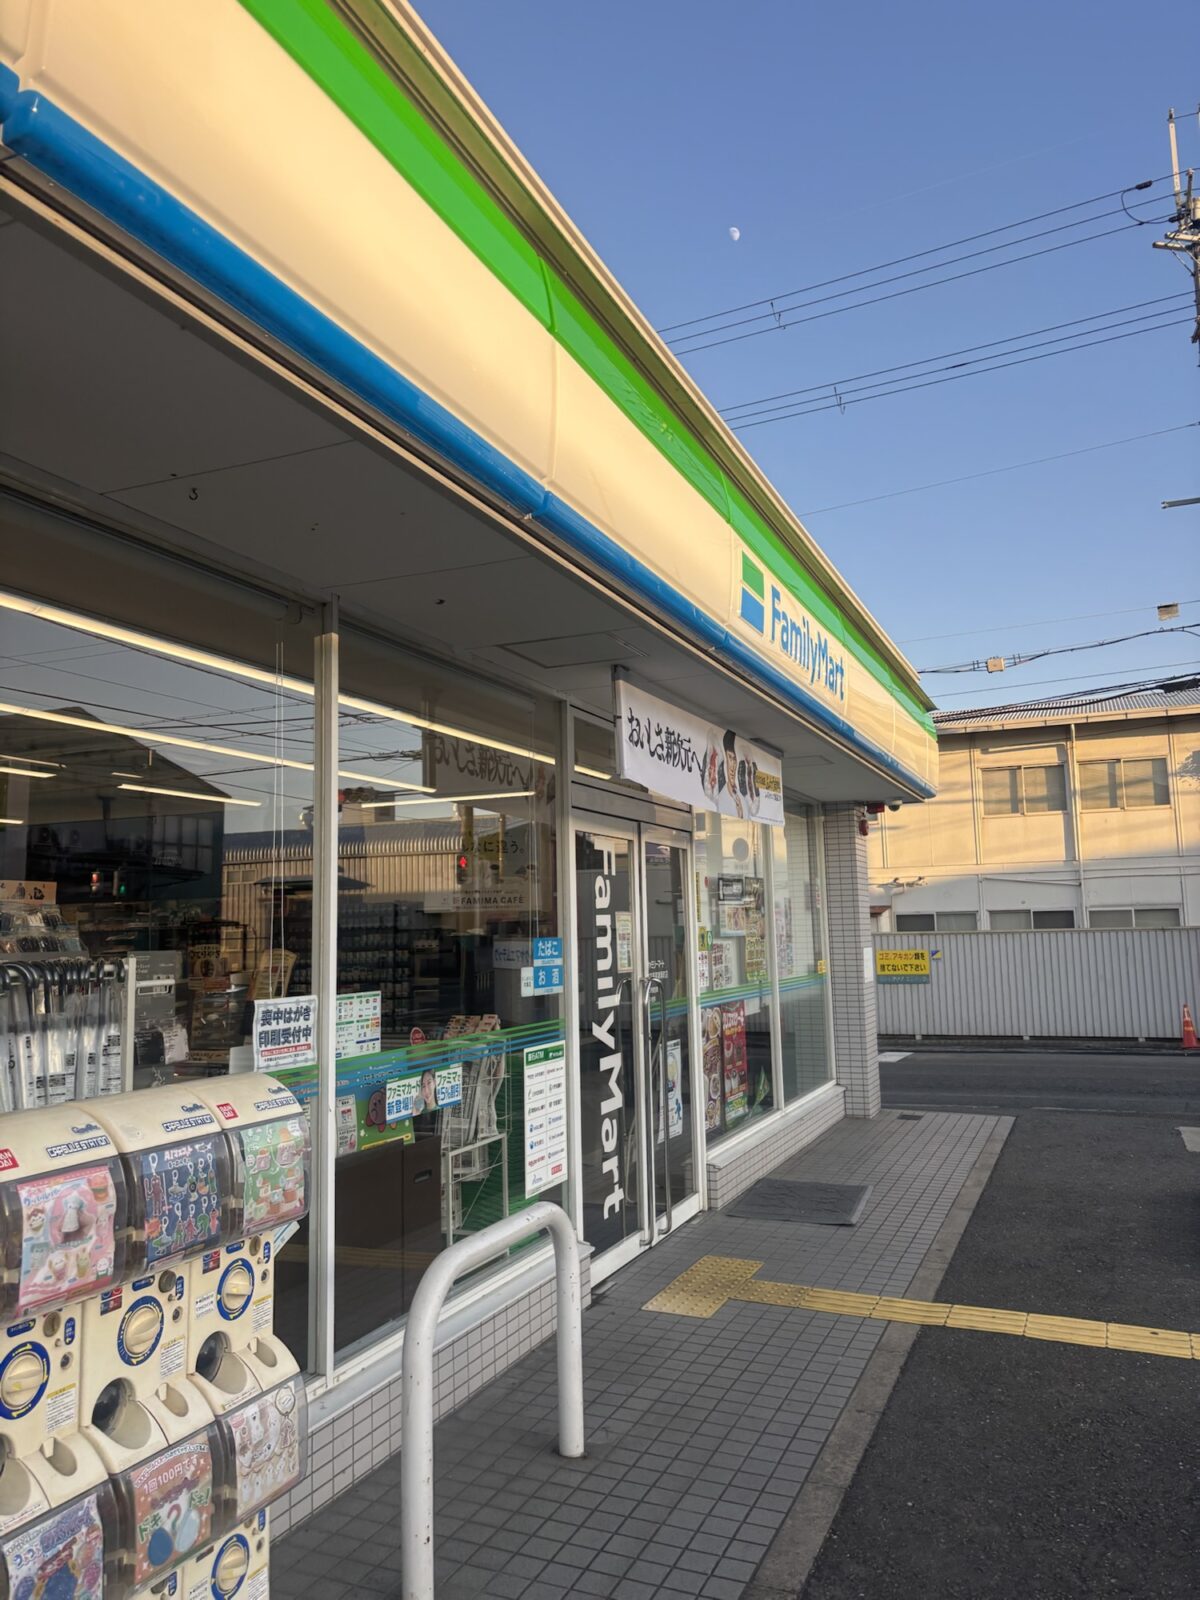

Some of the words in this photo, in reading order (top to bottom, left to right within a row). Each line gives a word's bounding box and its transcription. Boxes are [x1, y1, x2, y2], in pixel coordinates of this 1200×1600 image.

[771, 584, 844, 701] FamilyMart
[627, 707, 702, 773] おいしさ新次元へ
[538, 941, 559, 957] たばこ
[260, 1006, 311, 1026] 喪中はがき
[259, 1025, 311, 1048] 印刷受付中
[592, 838, 625, 1220] FamilyMart
[387, 1082, 421, 1100] ファミマカード
[162, 1118, 191, 1132] CAPSULE
[190, 1114, 214, 1127] STATION
[47, 1142, 81, 1158] CAPSULE
[80, 1136, 110, 1150] STATION
[143, 1454, 198, 1494] 1回100円です
